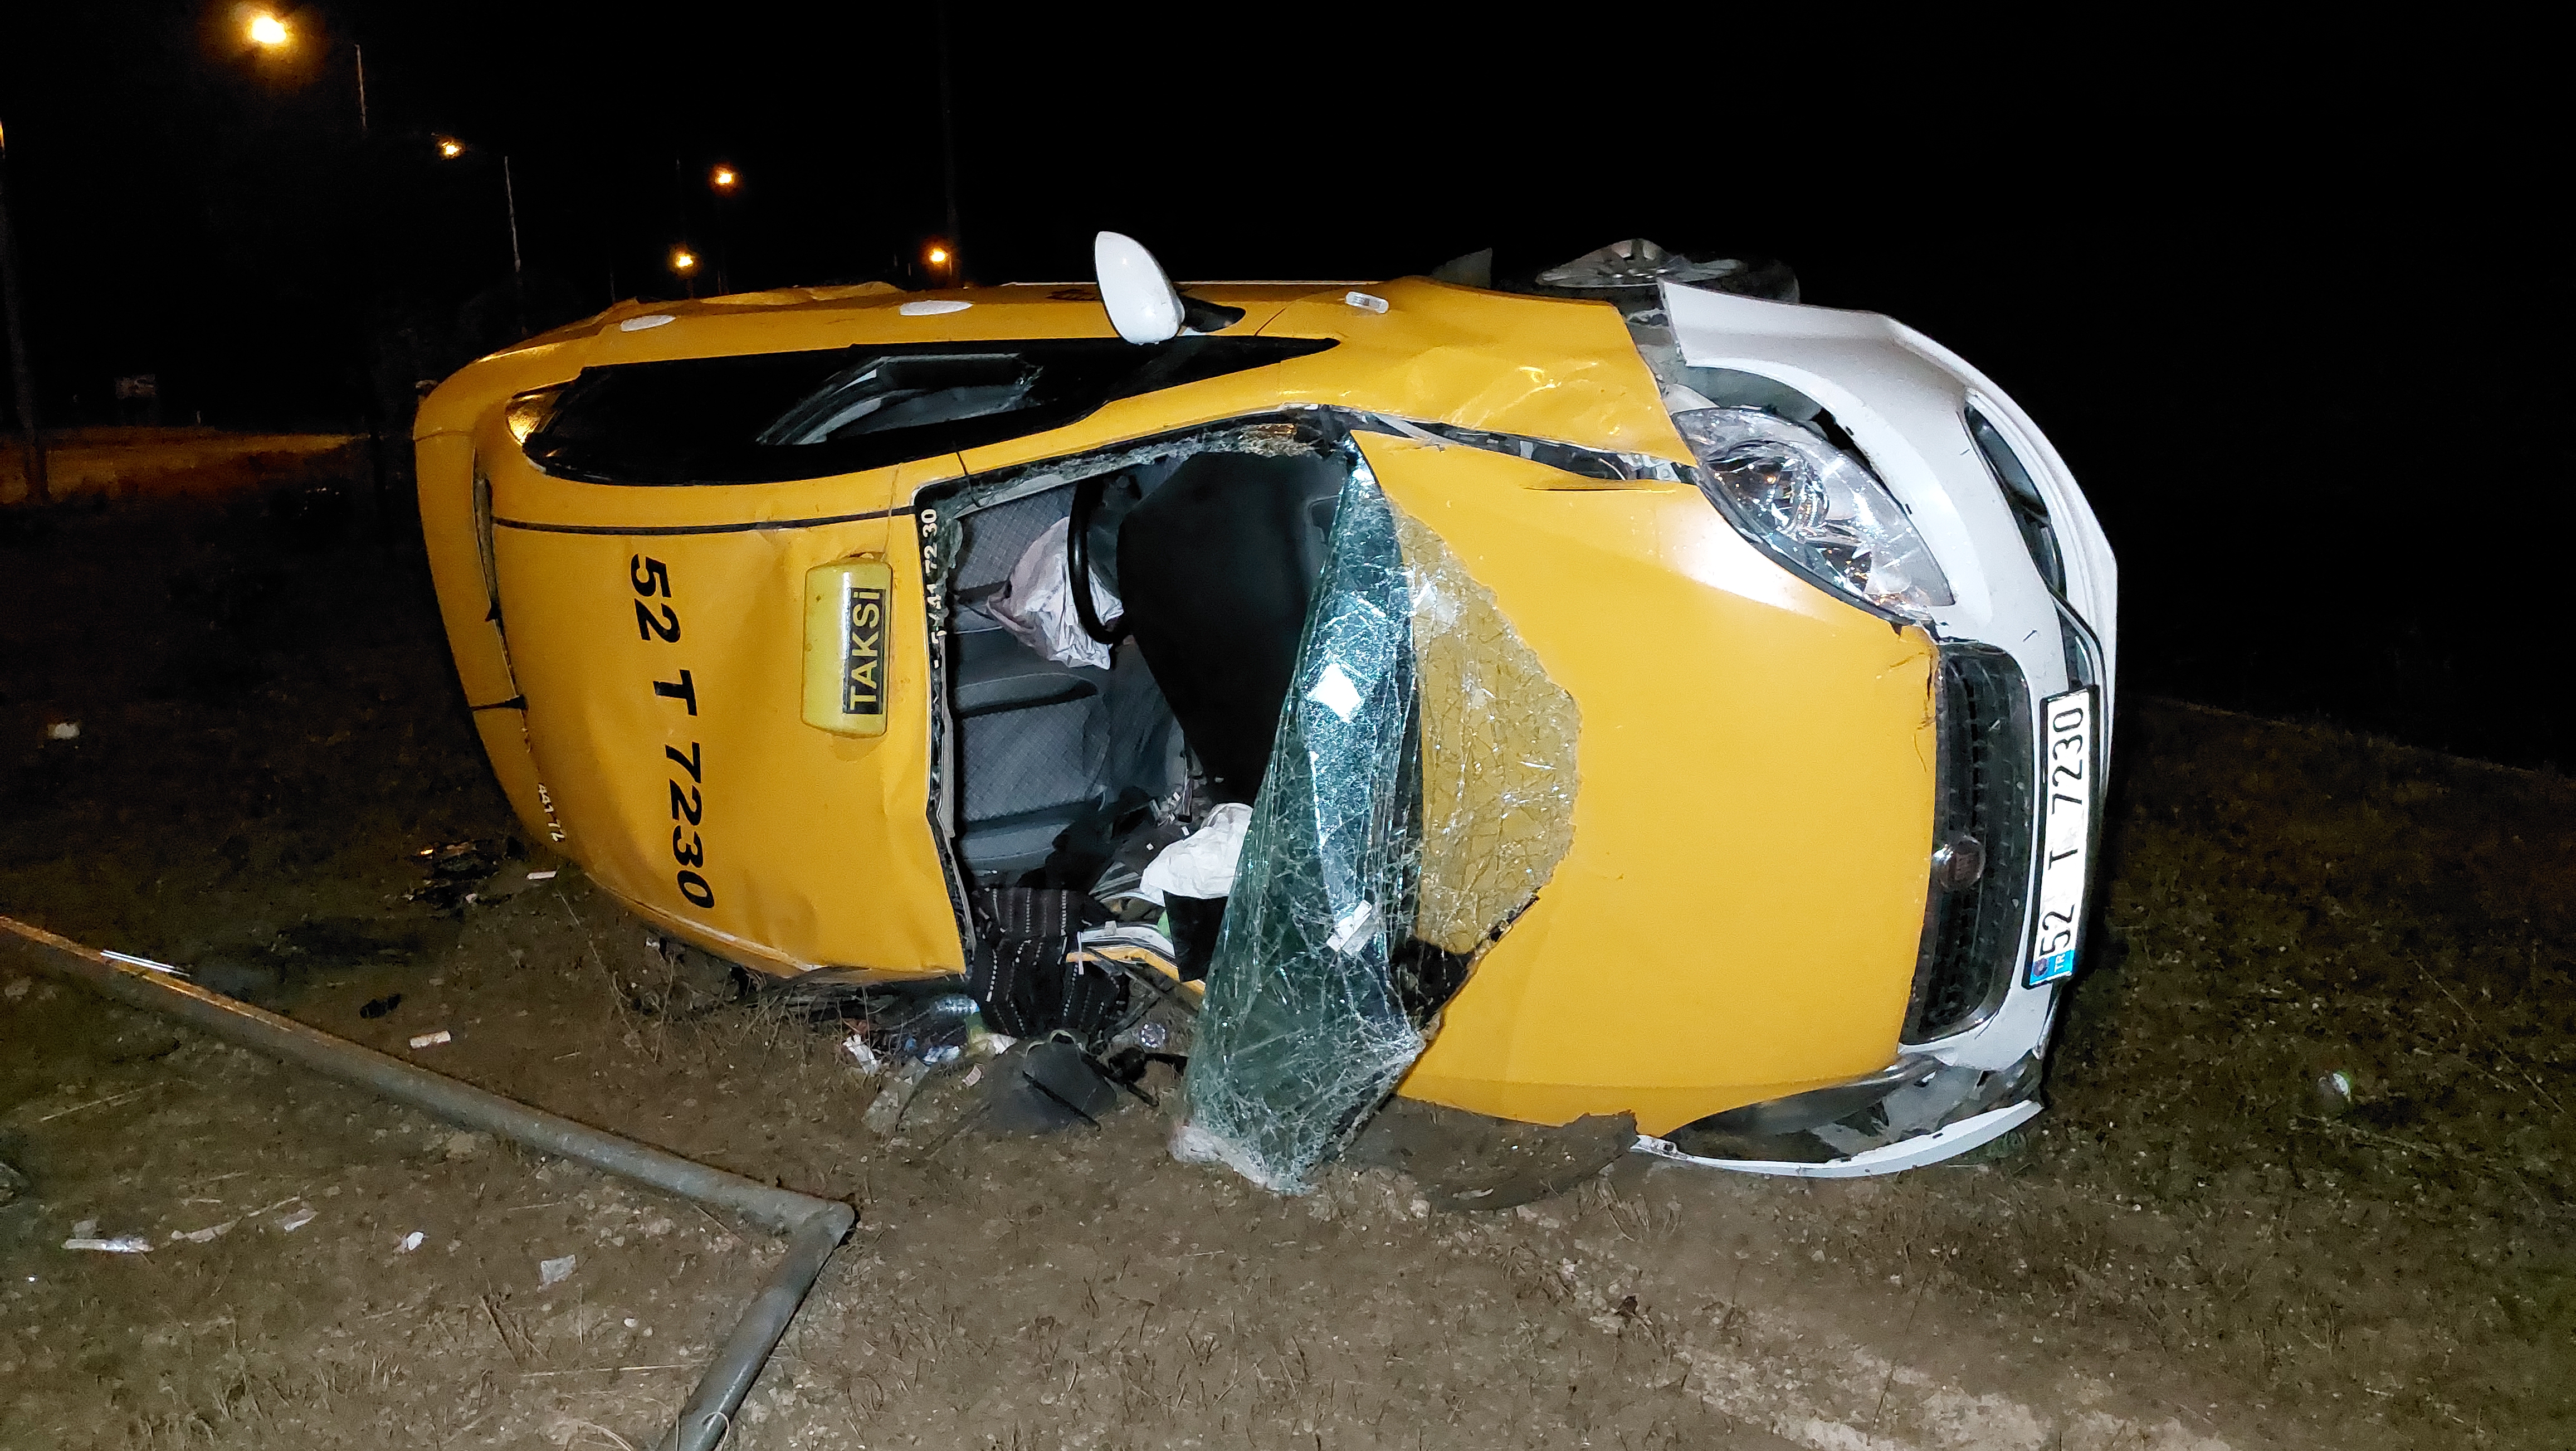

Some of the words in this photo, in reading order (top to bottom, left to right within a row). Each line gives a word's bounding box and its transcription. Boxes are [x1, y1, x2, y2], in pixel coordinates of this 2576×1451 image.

[921, 509, 938, 538] 30
[924, 542, 938, 574] 72
[631, 553, 681, 644] 52
[653, 669, 698, 717] T
[2051, 707, 2084, 815] 7230
[665, 741, 715, 909] 7230
[2047, 848, 2079, 870] T
[2040, 904, 2075, 957] 52
[2054, 951, 2065, 972] TR
